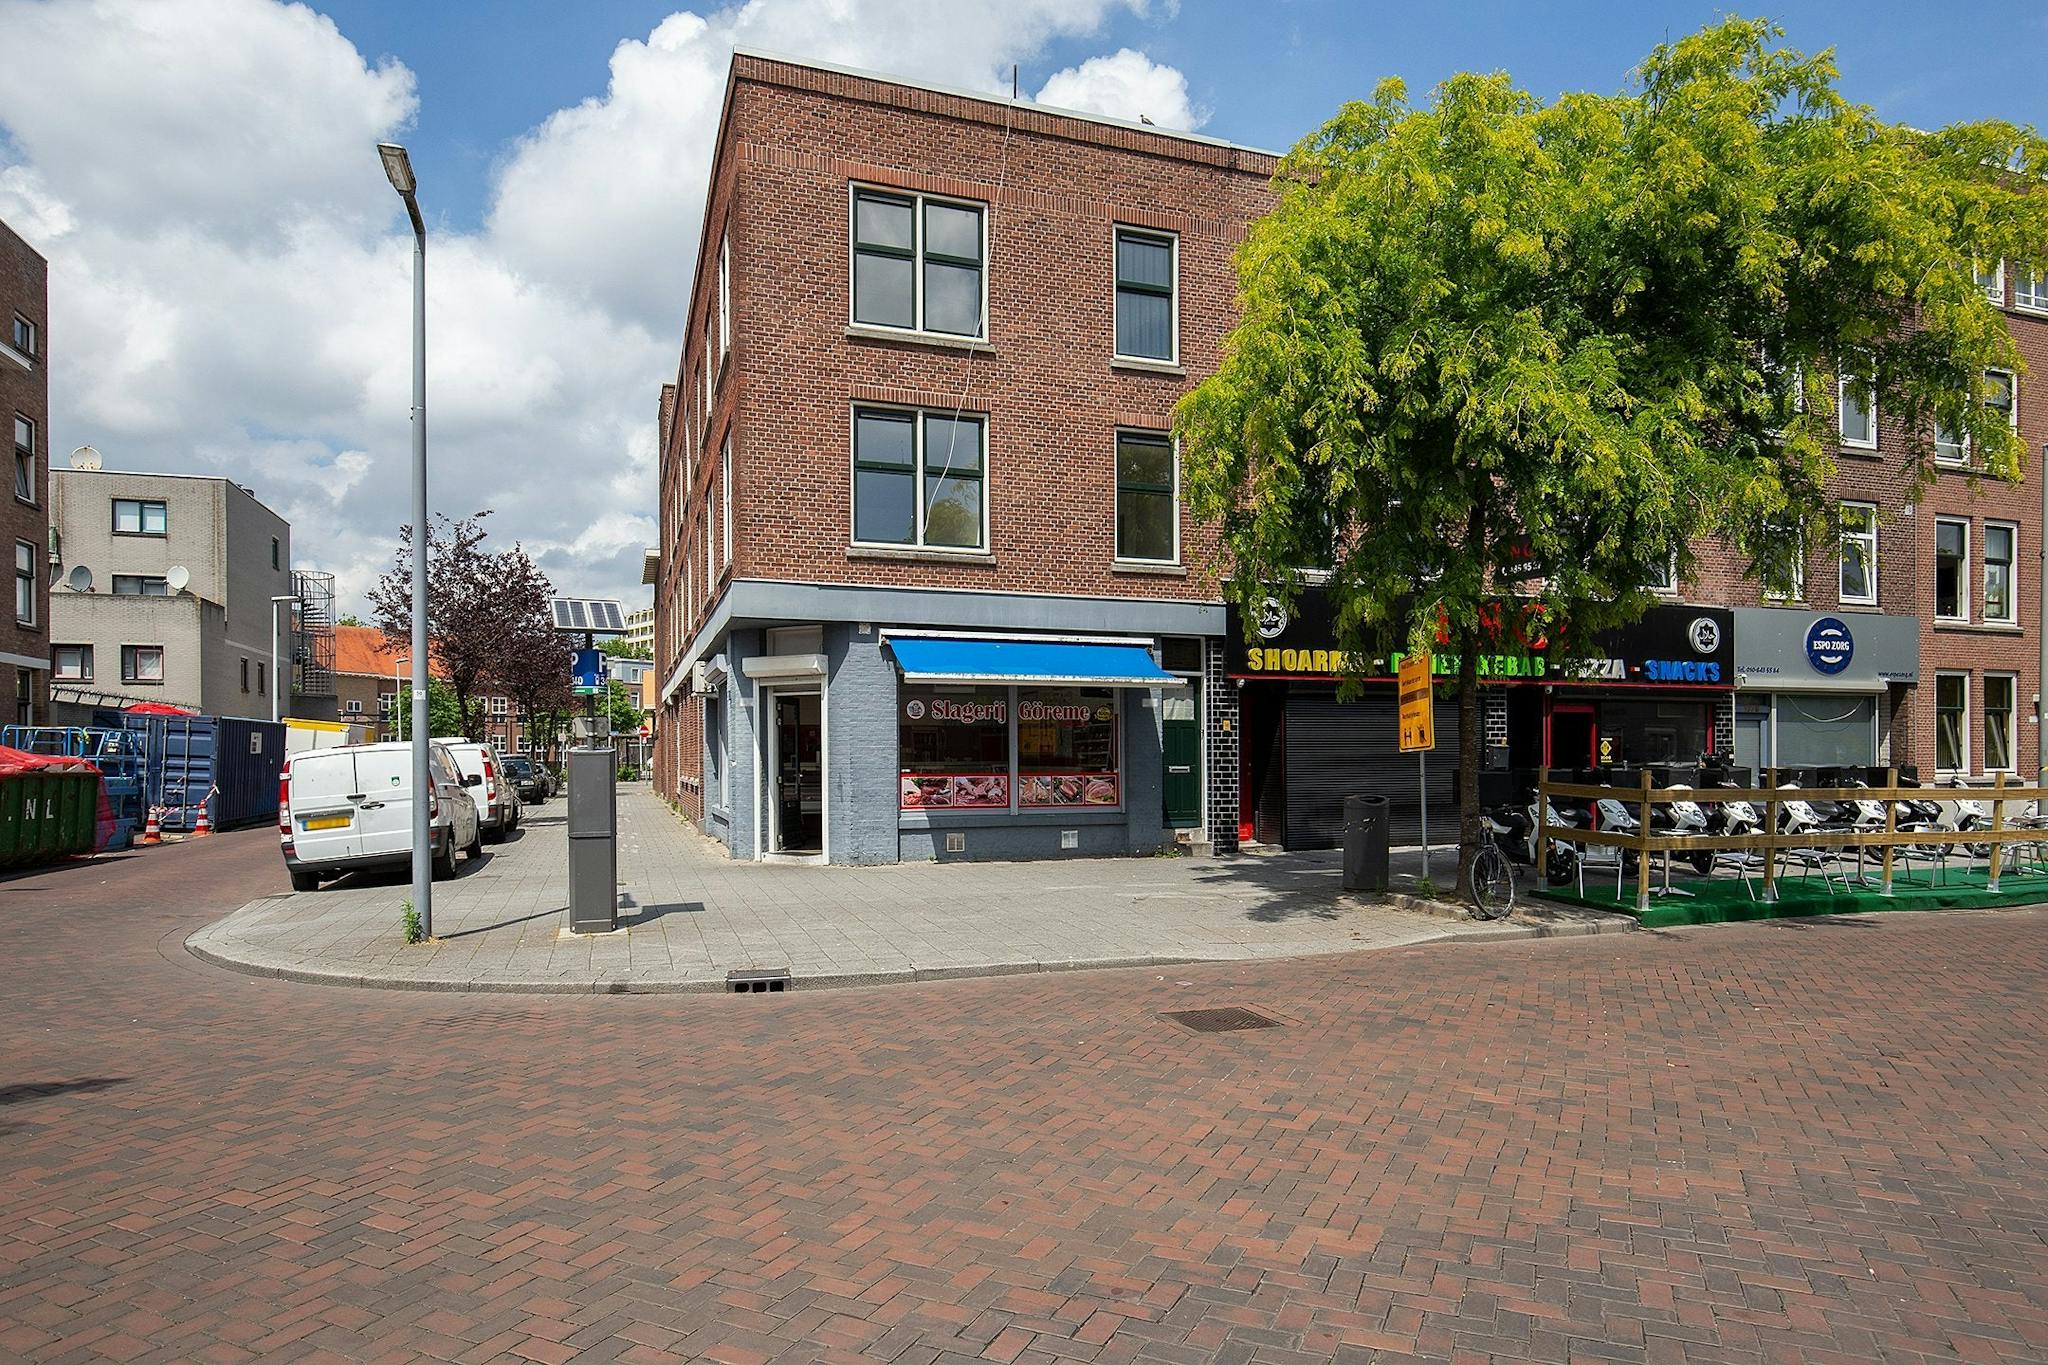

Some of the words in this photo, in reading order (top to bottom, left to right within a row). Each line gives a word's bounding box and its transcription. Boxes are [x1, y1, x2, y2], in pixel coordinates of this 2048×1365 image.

[1813, 640, 1831, 650] ESPO
[1831, 640, 1850, 651] ZORG
[1248, 647, 1364, 673] SHOARM
[1564, 657, 1627, 680] ZZA
[1645, 659, 1720, 682] SNACKS
[931, 699, 1008, 724] Slagerij
[1018, 700, 1091, 722] Göreme
